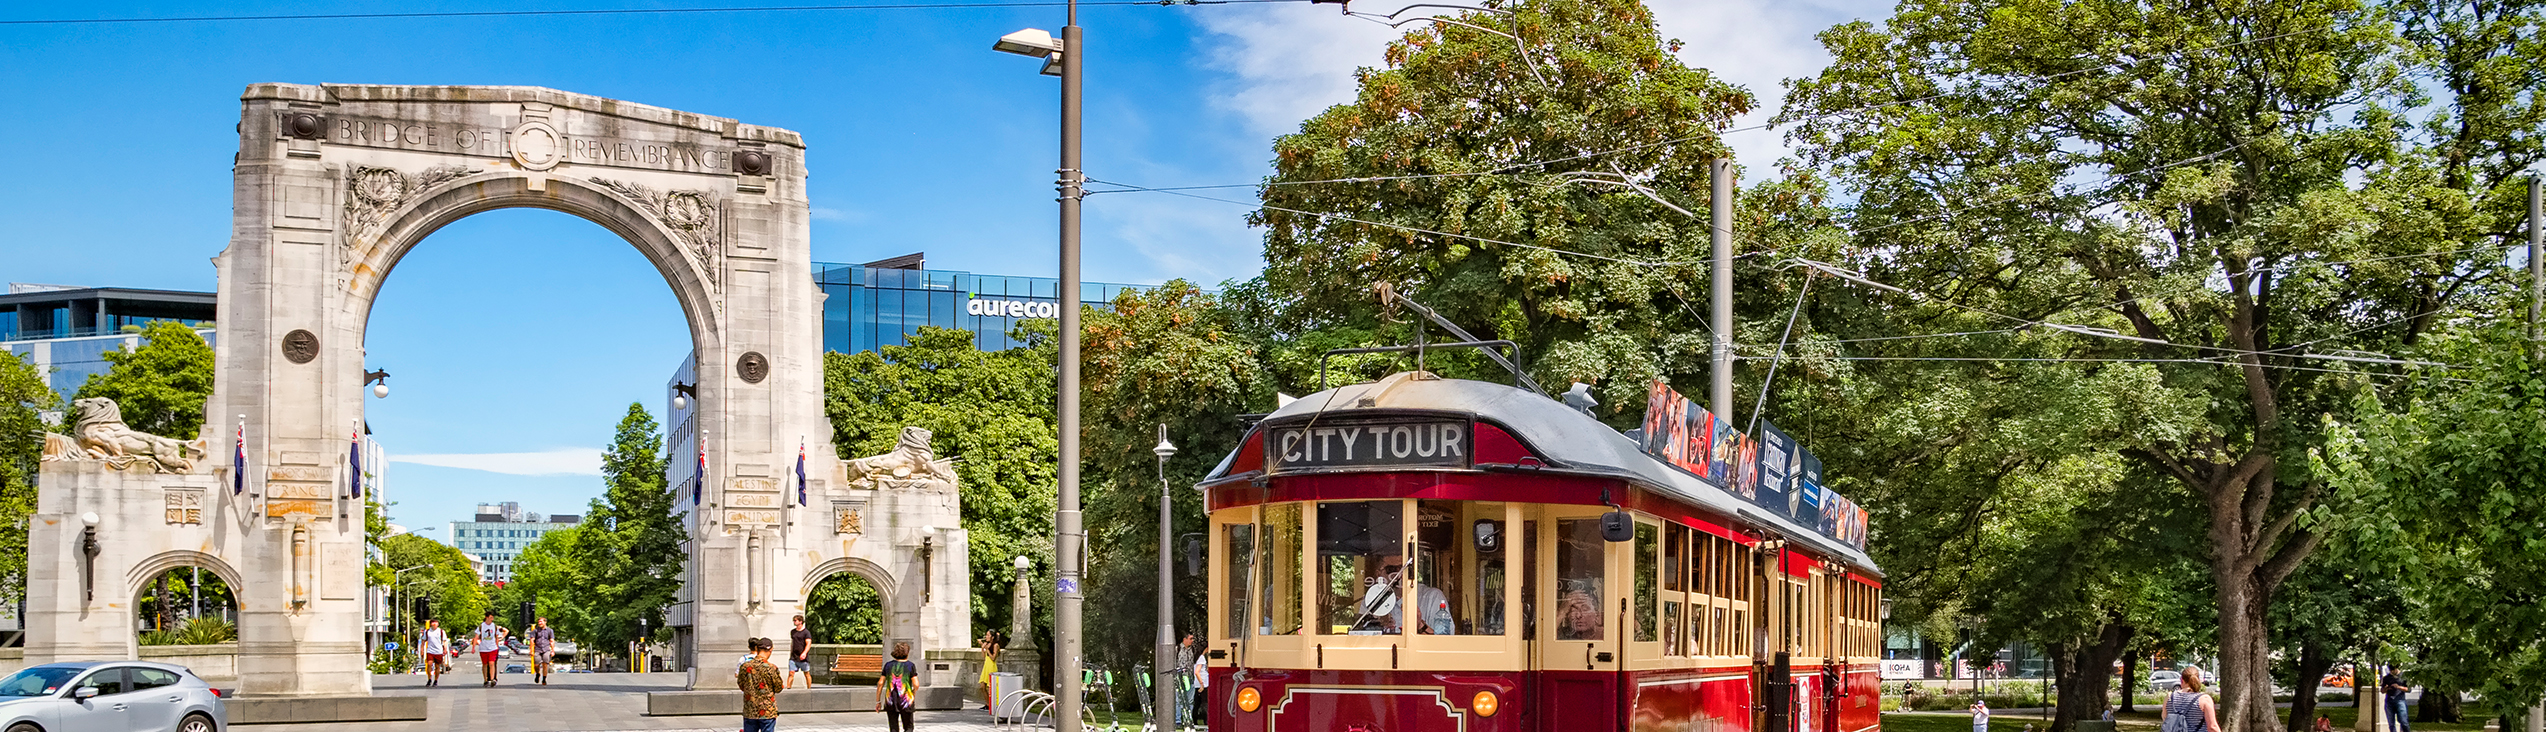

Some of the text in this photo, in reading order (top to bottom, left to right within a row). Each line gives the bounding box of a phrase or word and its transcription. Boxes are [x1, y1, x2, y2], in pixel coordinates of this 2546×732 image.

[340, 119, 728, 170] BRIDGE OF REMEMBRANCE
[1282, 424, 1463, 462] CITY TOUR
[729, 479, 778, 490] PALESTINE
[273, 485, 326, 497] FRANCE
[736, 494, 771, 506] EGYPT
[727, 511, 780, 524] GALLIPOLI
